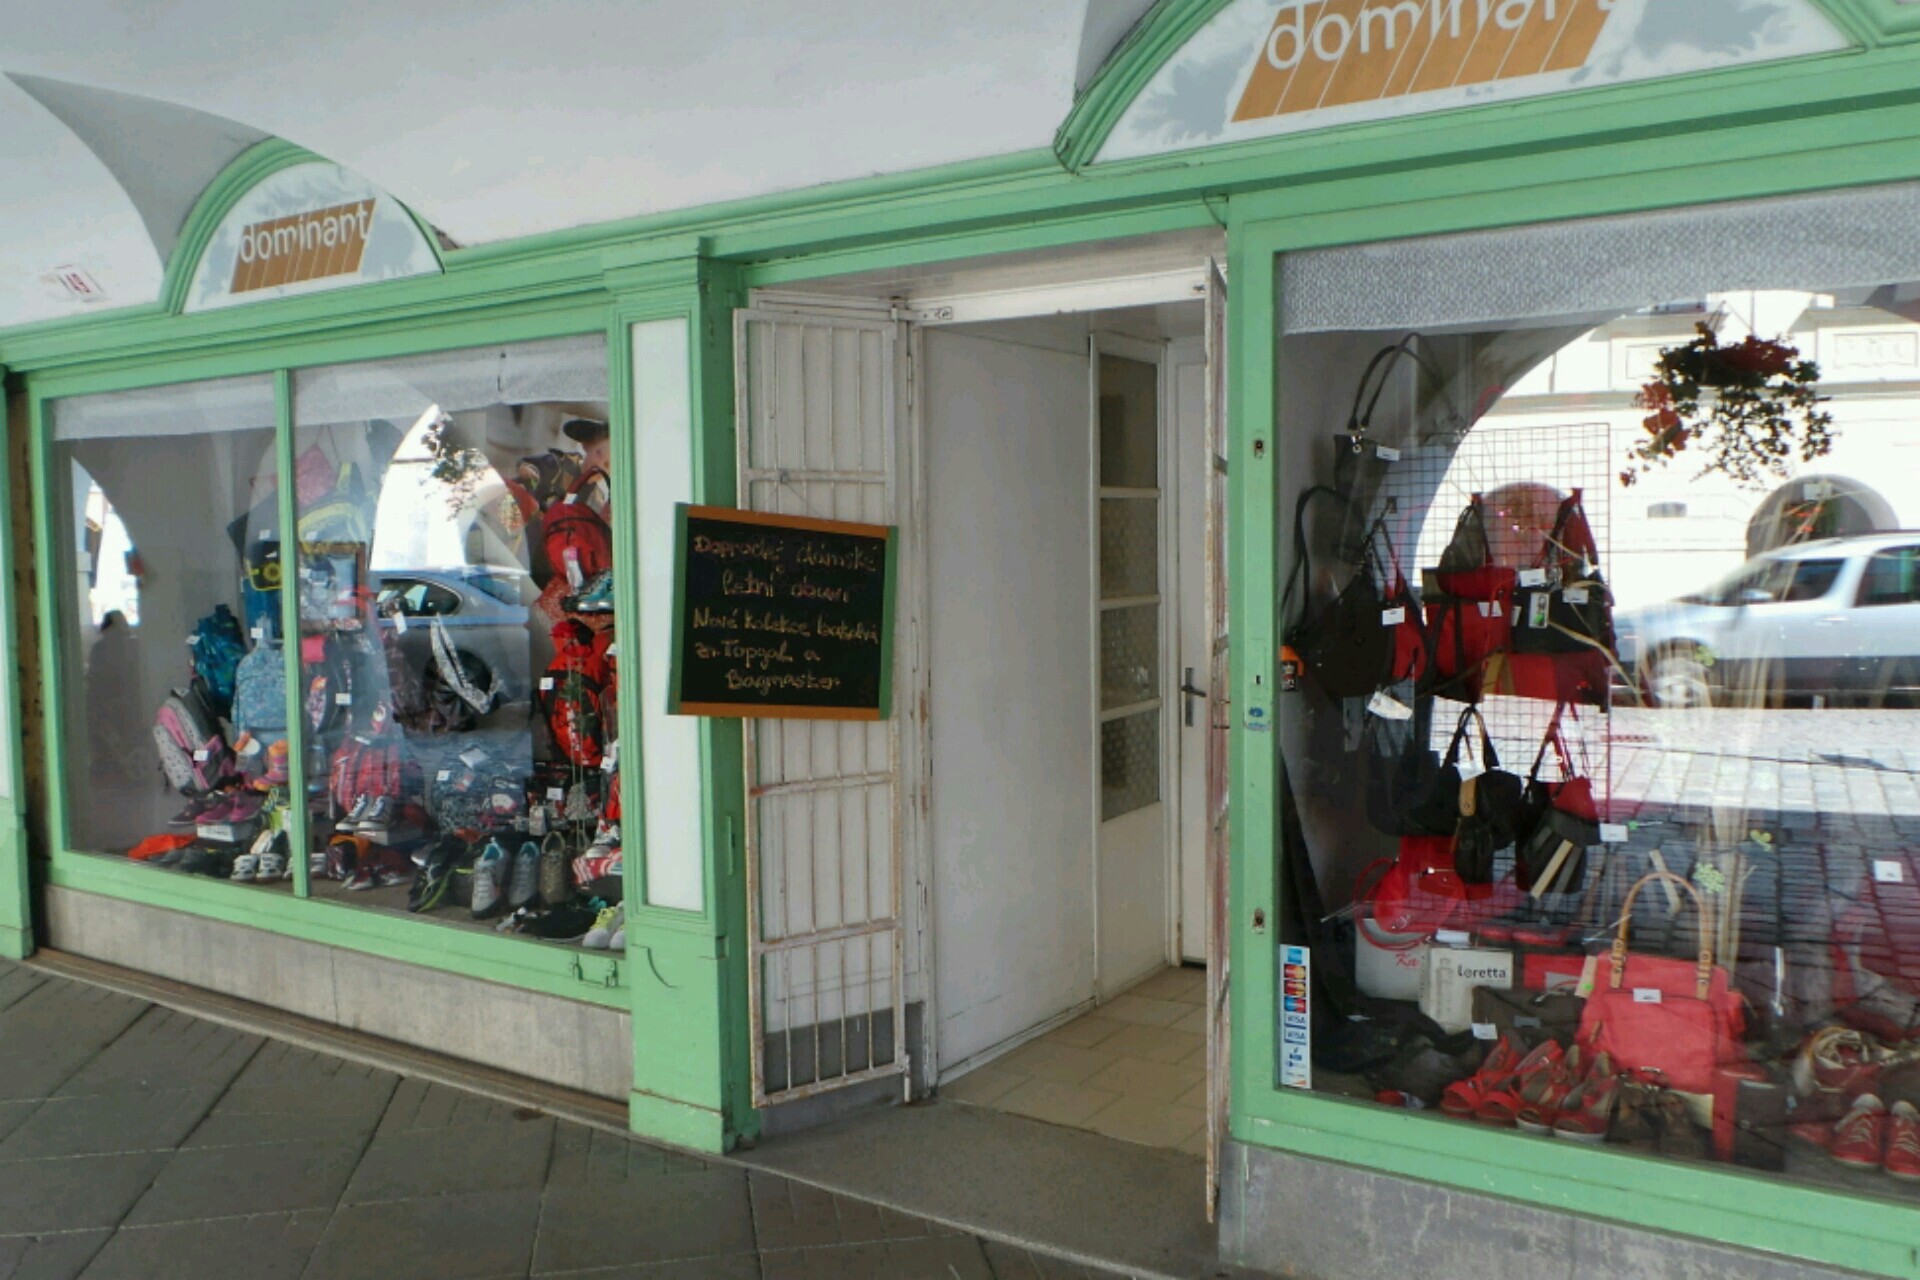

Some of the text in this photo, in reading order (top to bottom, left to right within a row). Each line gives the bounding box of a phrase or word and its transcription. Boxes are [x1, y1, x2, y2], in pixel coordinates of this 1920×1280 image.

[1267, 0, 1616, 70] domina
[240, 202, 368, 263] dominant
[693, 606, 739, 629] Nové
[804, 647, 822, 661] a
